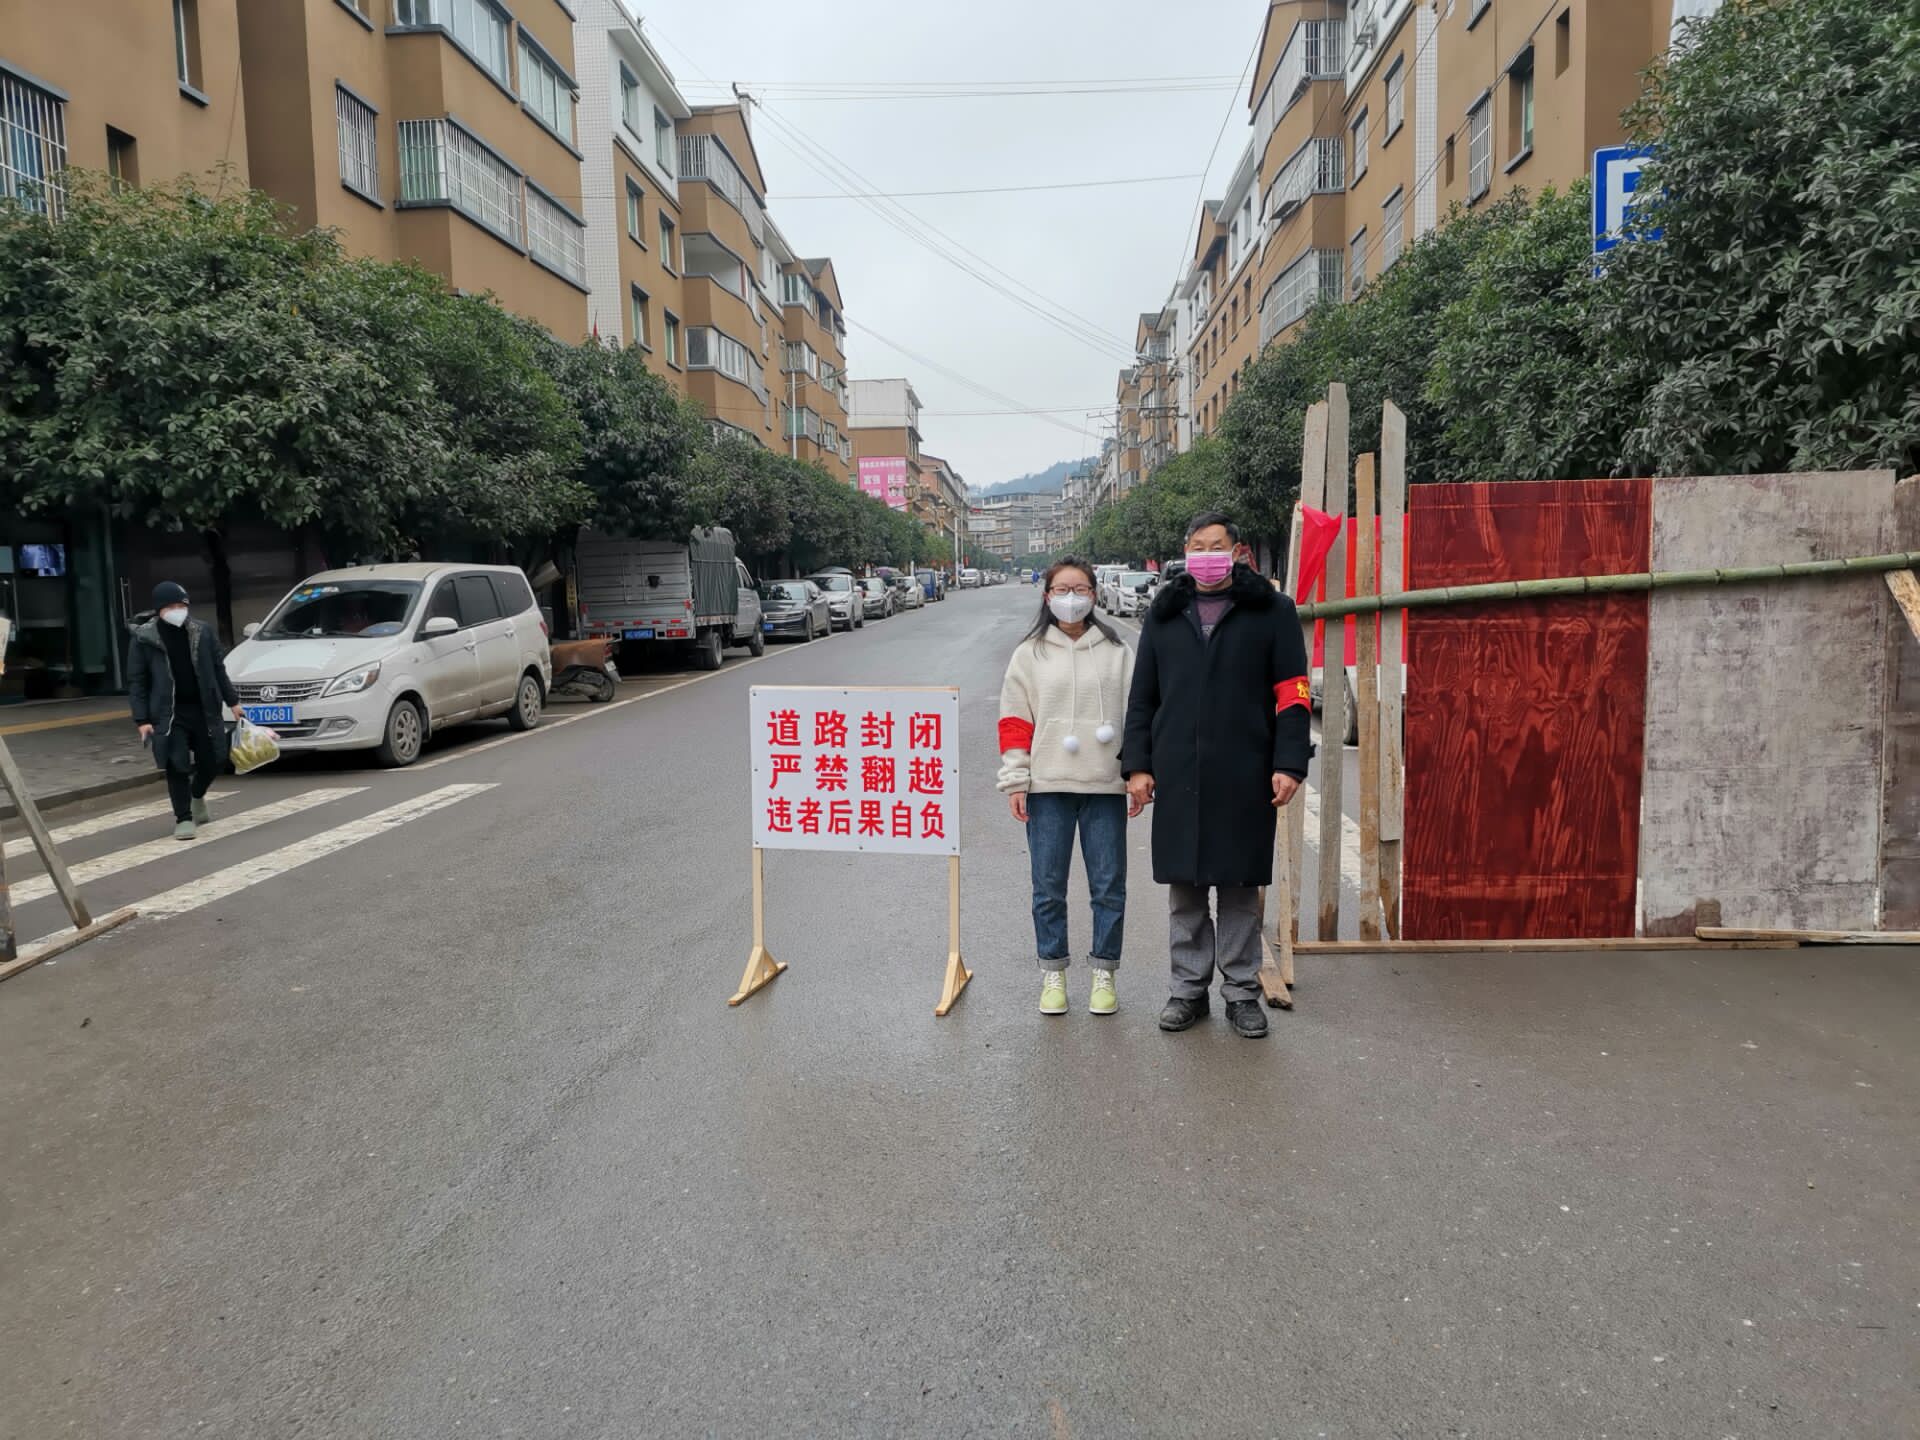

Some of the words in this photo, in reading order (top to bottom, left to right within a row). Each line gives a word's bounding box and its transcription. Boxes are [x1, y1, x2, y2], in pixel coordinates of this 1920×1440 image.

[767, 709, 942, 750] 道路封闭
[769, 753, 945, 795] 严禁翻越
[767, 796, 945, 838] 违者后果自负
